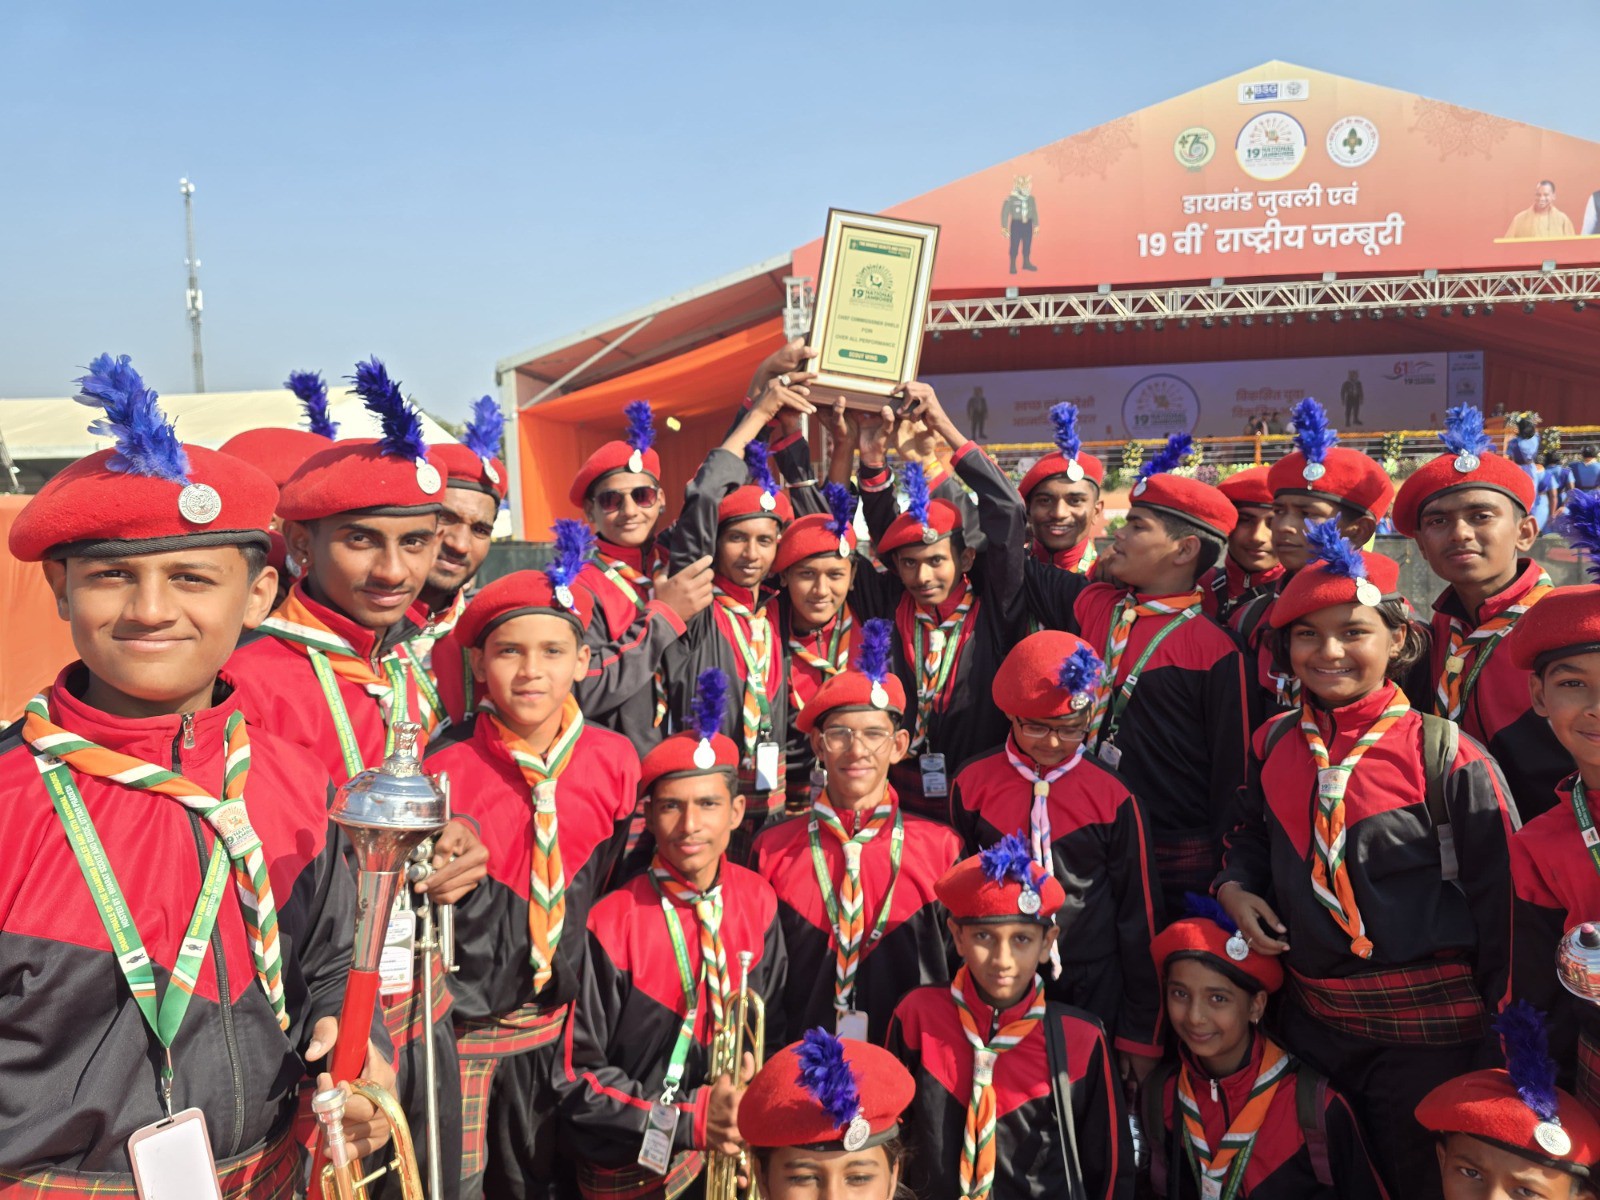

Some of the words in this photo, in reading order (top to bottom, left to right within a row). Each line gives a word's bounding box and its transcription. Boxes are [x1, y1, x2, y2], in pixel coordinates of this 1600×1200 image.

[1247, 148, 1260, 158] 19
[1182, 187, 1253, 215] डायमंड
[1257, 183, 1322, 216] जुबली
[1326, 181, 1359, 206] एवं
[1137, 233, 1167, 257] 19
[1172, 222, 1209, 255] वीं
[1214, 218, 1307, 254] राष्ट्रीय
[1311, 212, 1405, 256] जम्बूरी
[852, 288, 864, 298] 19
[858, 337, 896, 348] PERFORMANCE
[1134, 414, 1149, 425] 19
[49, 771, 64, 796] JAMBOREE
[64, 783, 79, 808] PRADESH
[59, 794, 74, 819] NATIONAL
[73, 806, 87, 825] UTTAR
[75, 832, 85, 845] AND
[88, 841, 99, 855] AND
[94, 854, 107, 873] SCOUT
[89, 866, 105, 893] DIAMOND
[101, 871, 116, 894] BHARAT
[99, 892, 109, 904] THE
[105, 903, 113, 912] OF
[111, 896, 120, 905] BY
[108, 911, 121, 931] FINALE
[114, 904, 130, 928] HOSTED
[116, 931, 129, 951] GRAND
